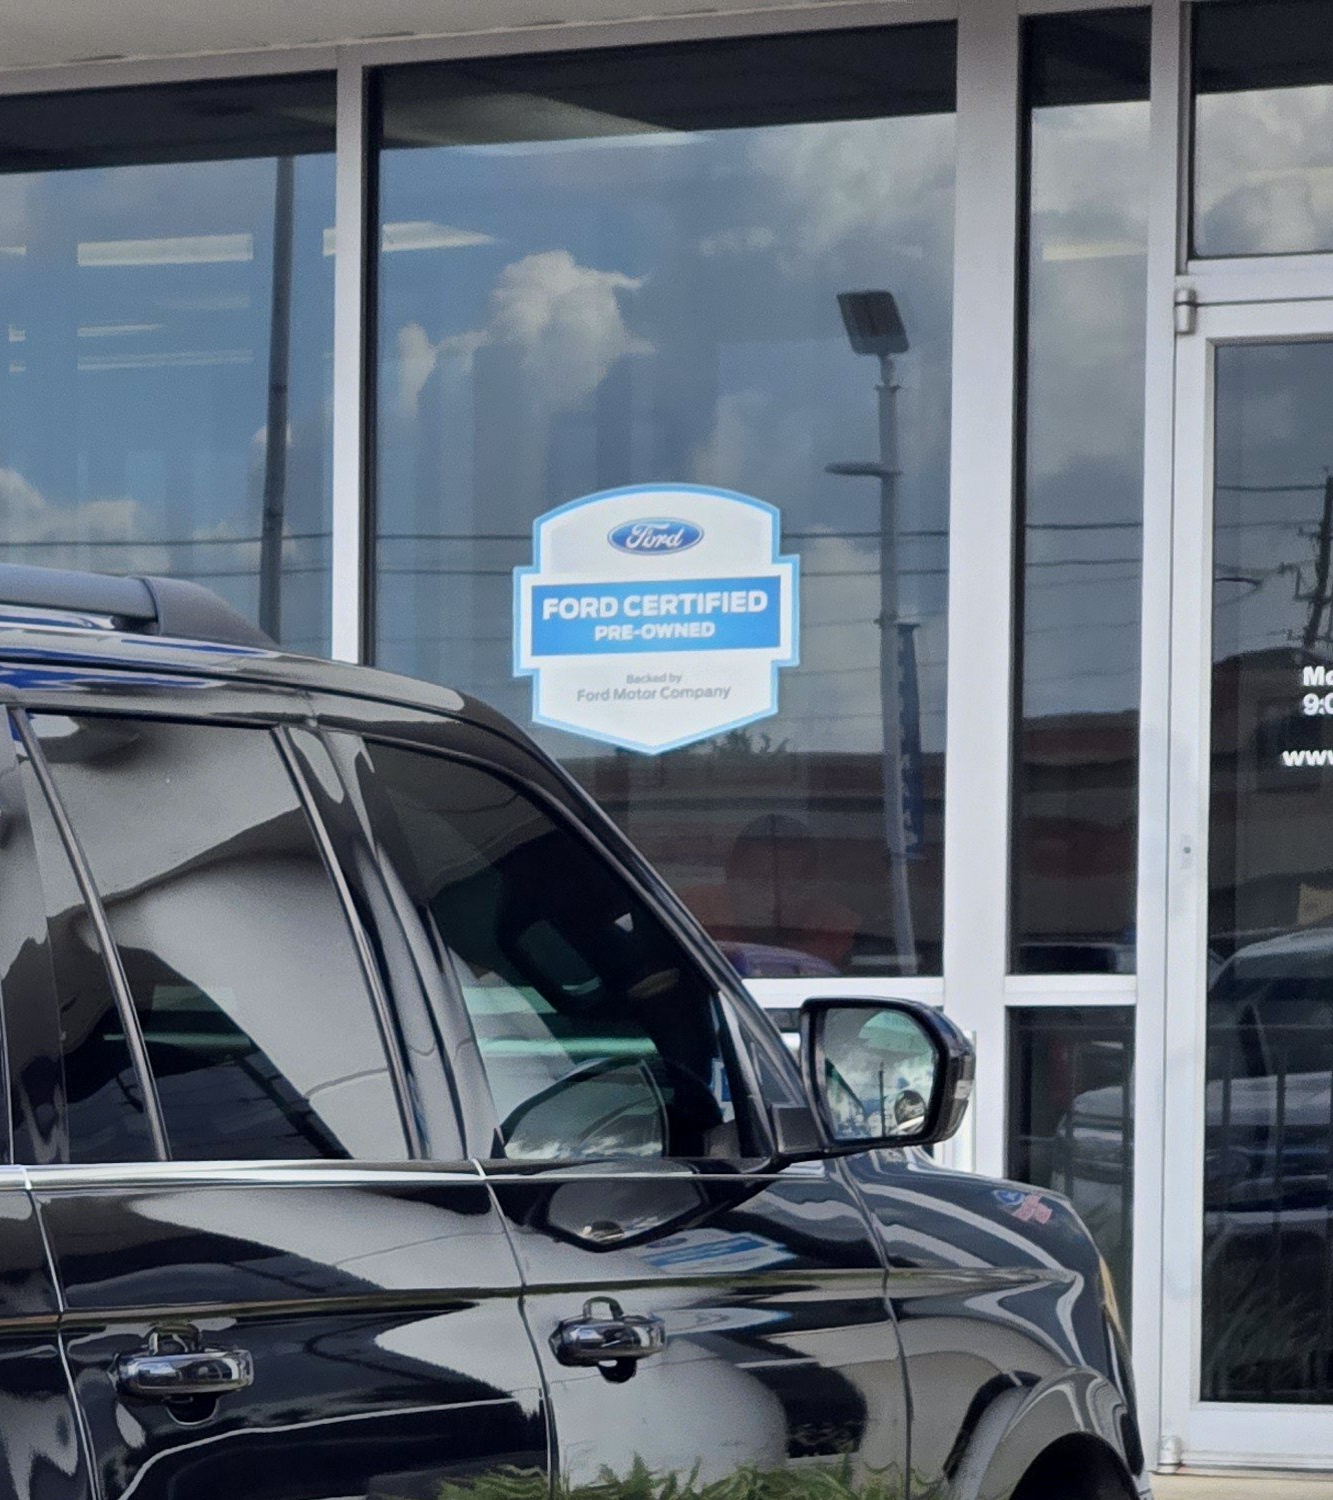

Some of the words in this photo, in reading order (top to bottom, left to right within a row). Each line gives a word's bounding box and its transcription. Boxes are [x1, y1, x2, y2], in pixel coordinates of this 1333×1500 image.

[625, 523, 686, 549] Ford
[542, 595, 619, 620] FORD
[623, 590, 769, 618] CERTIFIED
[594, 621, 716, 642] PRE-OWNED
[626, 674, 667, 685] Backed
[669, 673, 682, 685] by
[576, 689, 610, 702] Ford
[613, 688, 657, 701] Motor
[660, 685, 731, 701] Company
[1282, 750, 1333, 767] ww
